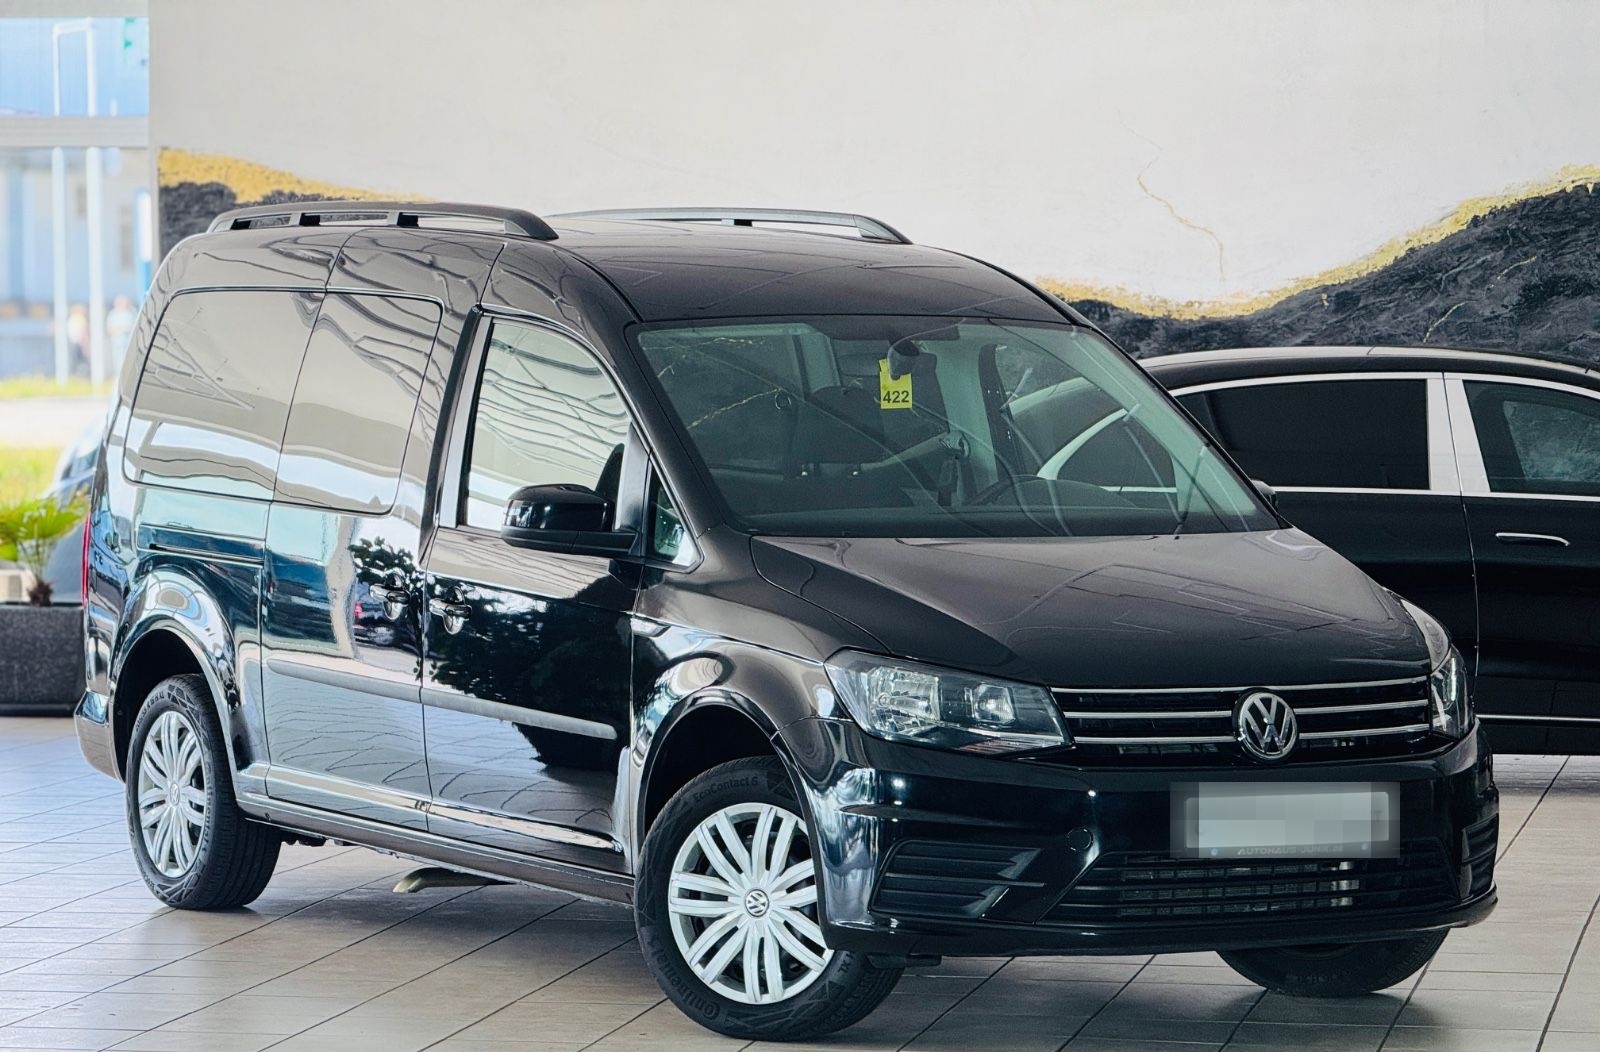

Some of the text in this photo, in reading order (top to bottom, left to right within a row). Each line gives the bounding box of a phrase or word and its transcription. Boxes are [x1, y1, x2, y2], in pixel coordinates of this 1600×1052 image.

[883, 390, 910, 404] 422
[1239, 692, 1297, 759] VW
[693, 776, 759, 800] EcoContact 6
[651, 948, 721, 1021] Continental
